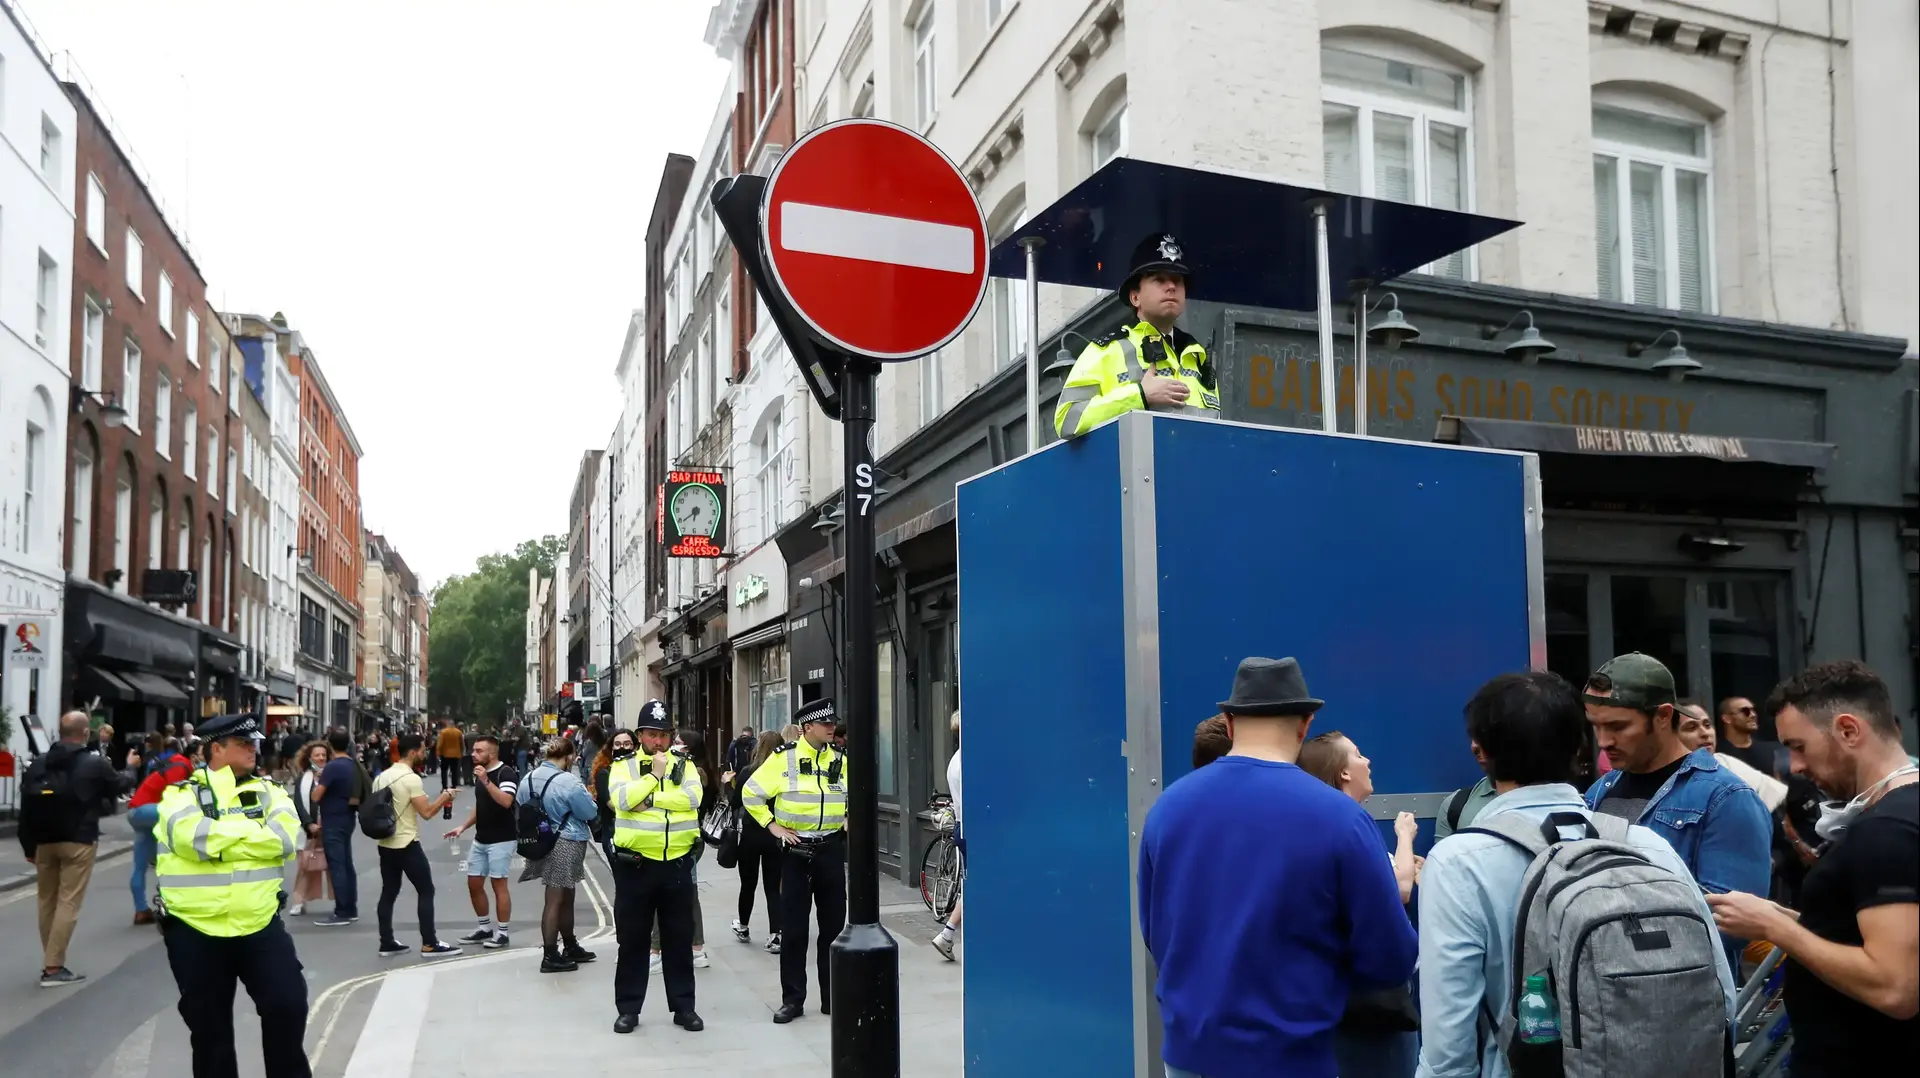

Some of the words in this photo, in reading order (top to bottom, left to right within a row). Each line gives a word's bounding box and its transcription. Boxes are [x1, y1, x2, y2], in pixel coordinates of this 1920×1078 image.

[1249, 355, 1416, 421] BALANS
[1435, 371, 1532, 421] SOHO
[1550, 386, 1696, 433] SOCIETY
[1576, 427, 1622, 452] HAVEN
[1624, 430, 1653, 453] FOR
[1653, 432, 1683, 454] THE
[671, 472, 690, 483] BAR
[856, 463, 872, 488] S
[857, 493, 872, 516] 7
